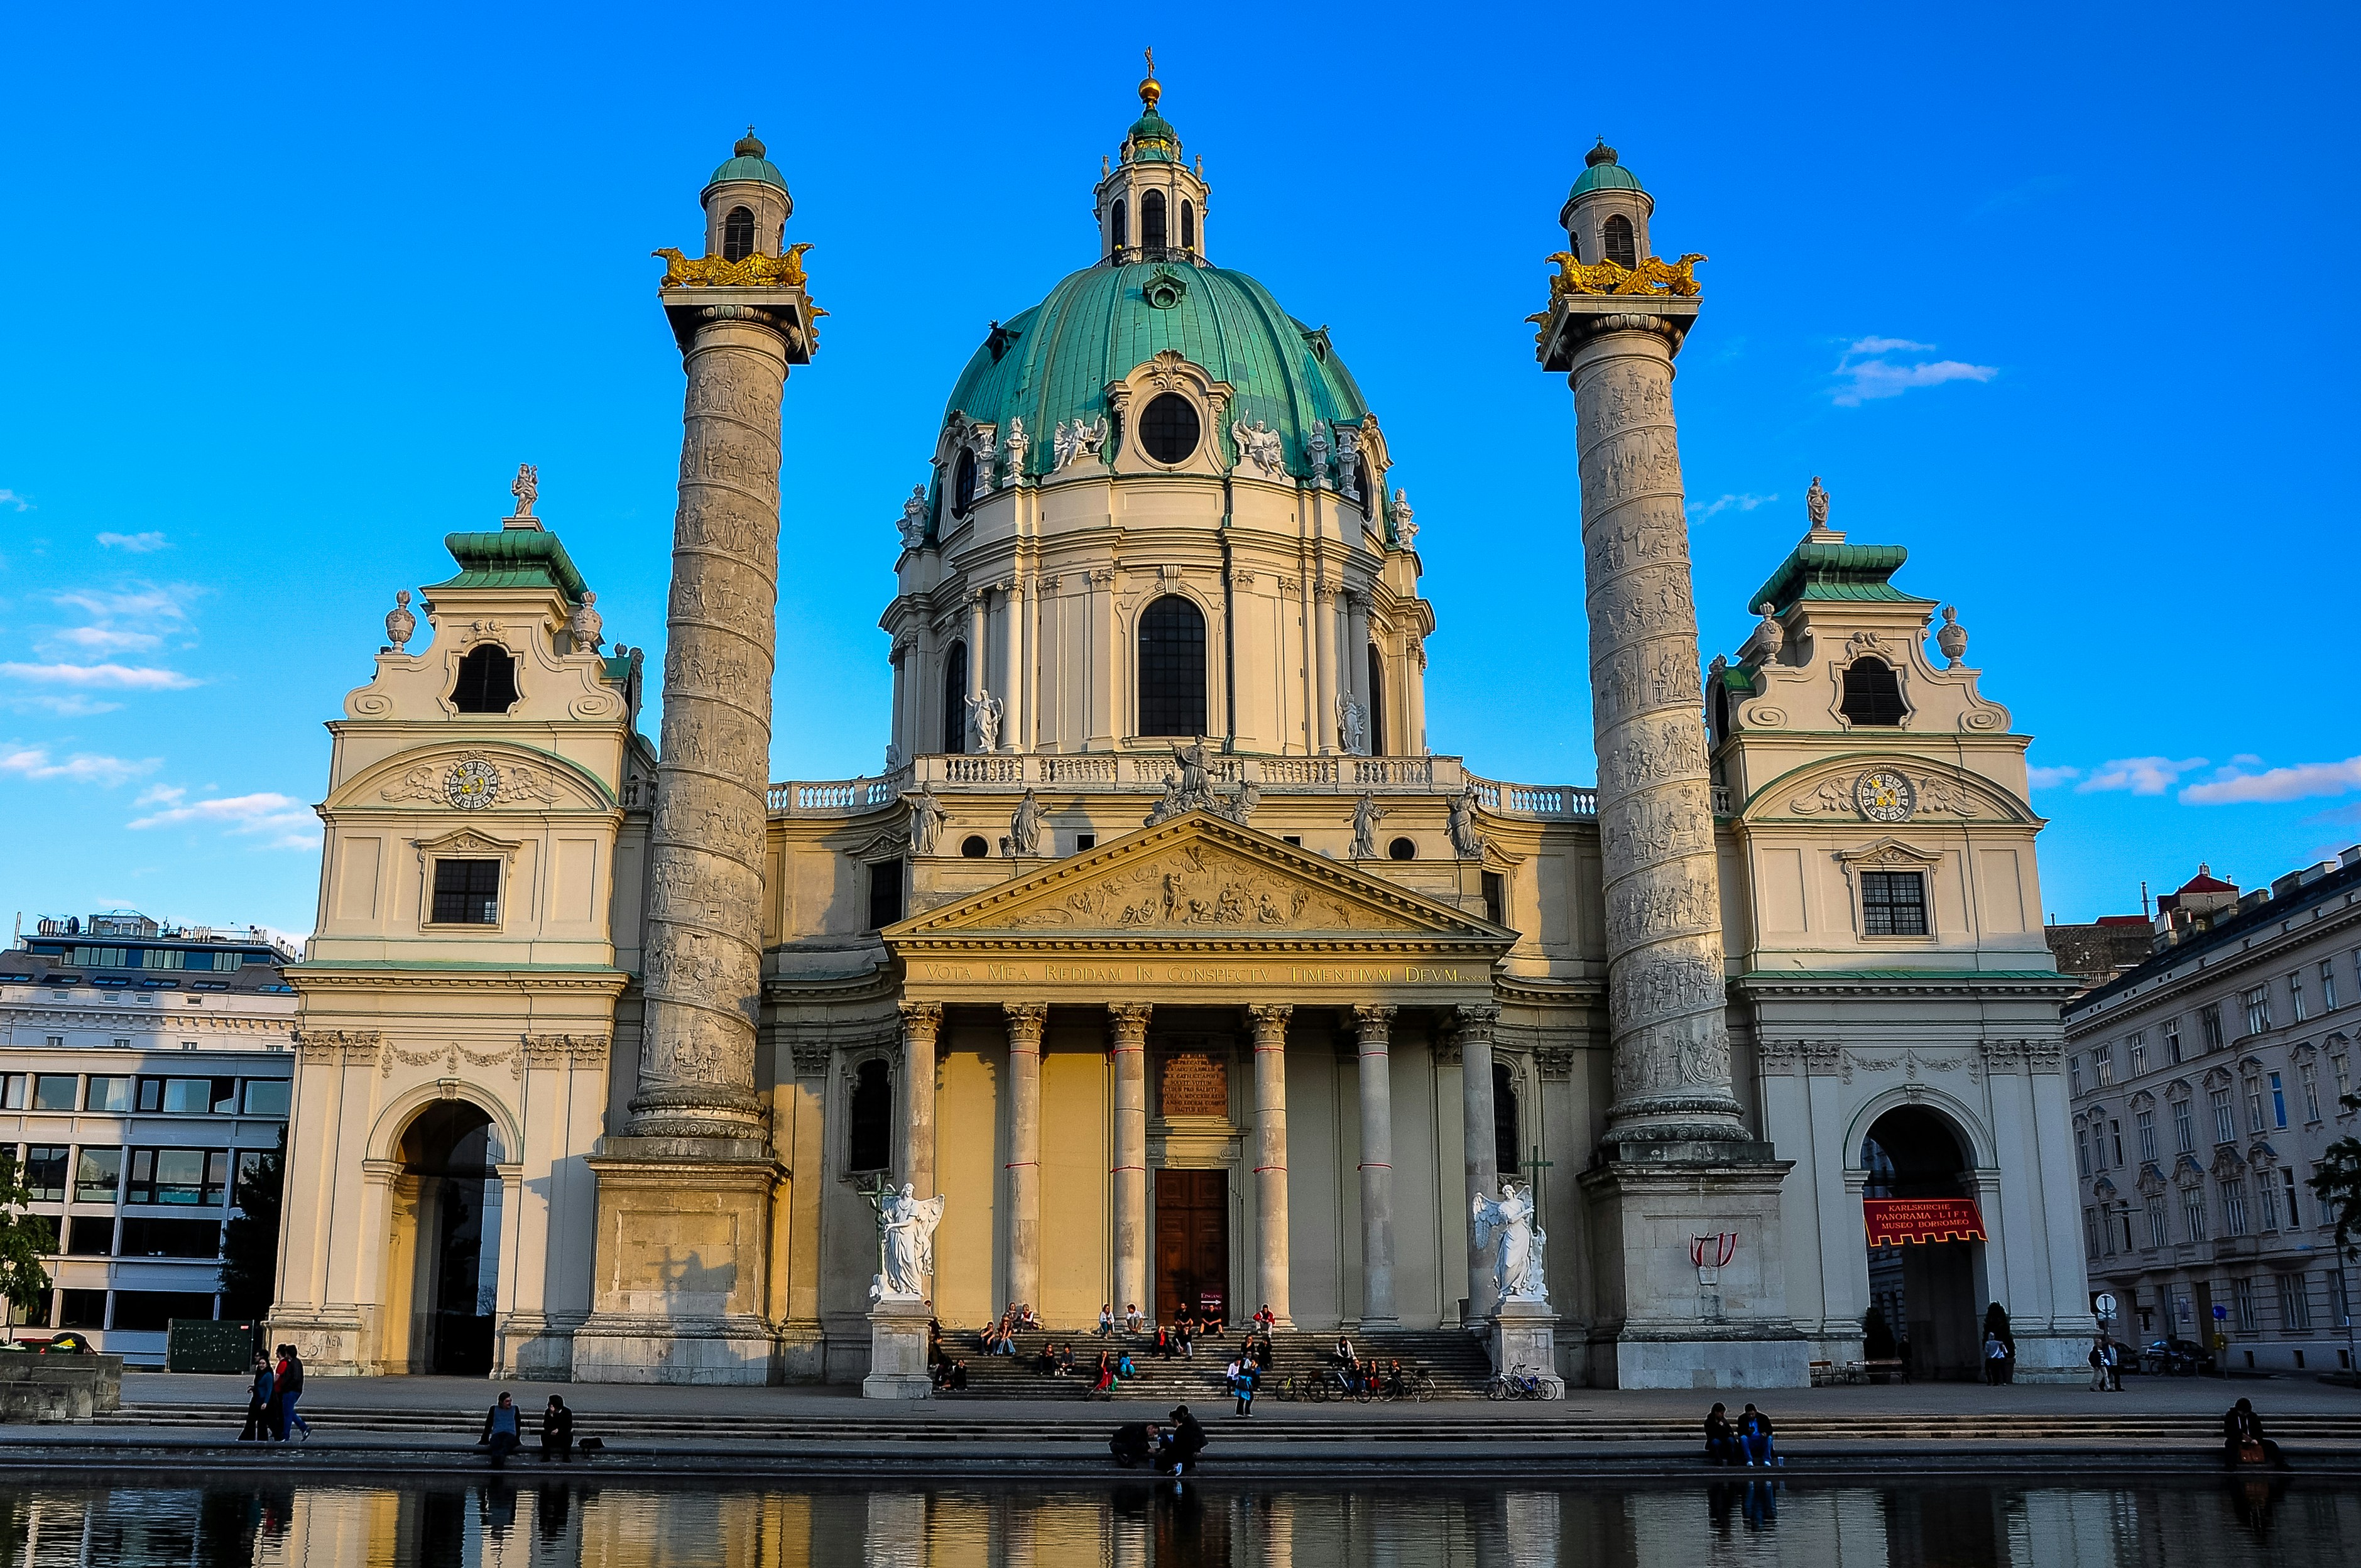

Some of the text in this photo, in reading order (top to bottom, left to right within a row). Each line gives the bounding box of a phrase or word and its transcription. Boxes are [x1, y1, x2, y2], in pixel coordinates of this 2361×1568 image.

[925, 964, 973, 980] VOTA
[988, 964, 1030, 980] MEA
[1045, 964, 1121, 981] REDDAM
[1137, 965, 1153, 981] IN
[1167, 966, 1272, 982] CONSPECTV
[1286, 966, 1391, 982] TIMENTIVM
[1405, 966, 1458, 982] DEVM
[1876, 1212, 1931, 1221] PANORAMA
[1918, 1219, 1969, 1228] BORROMEO
